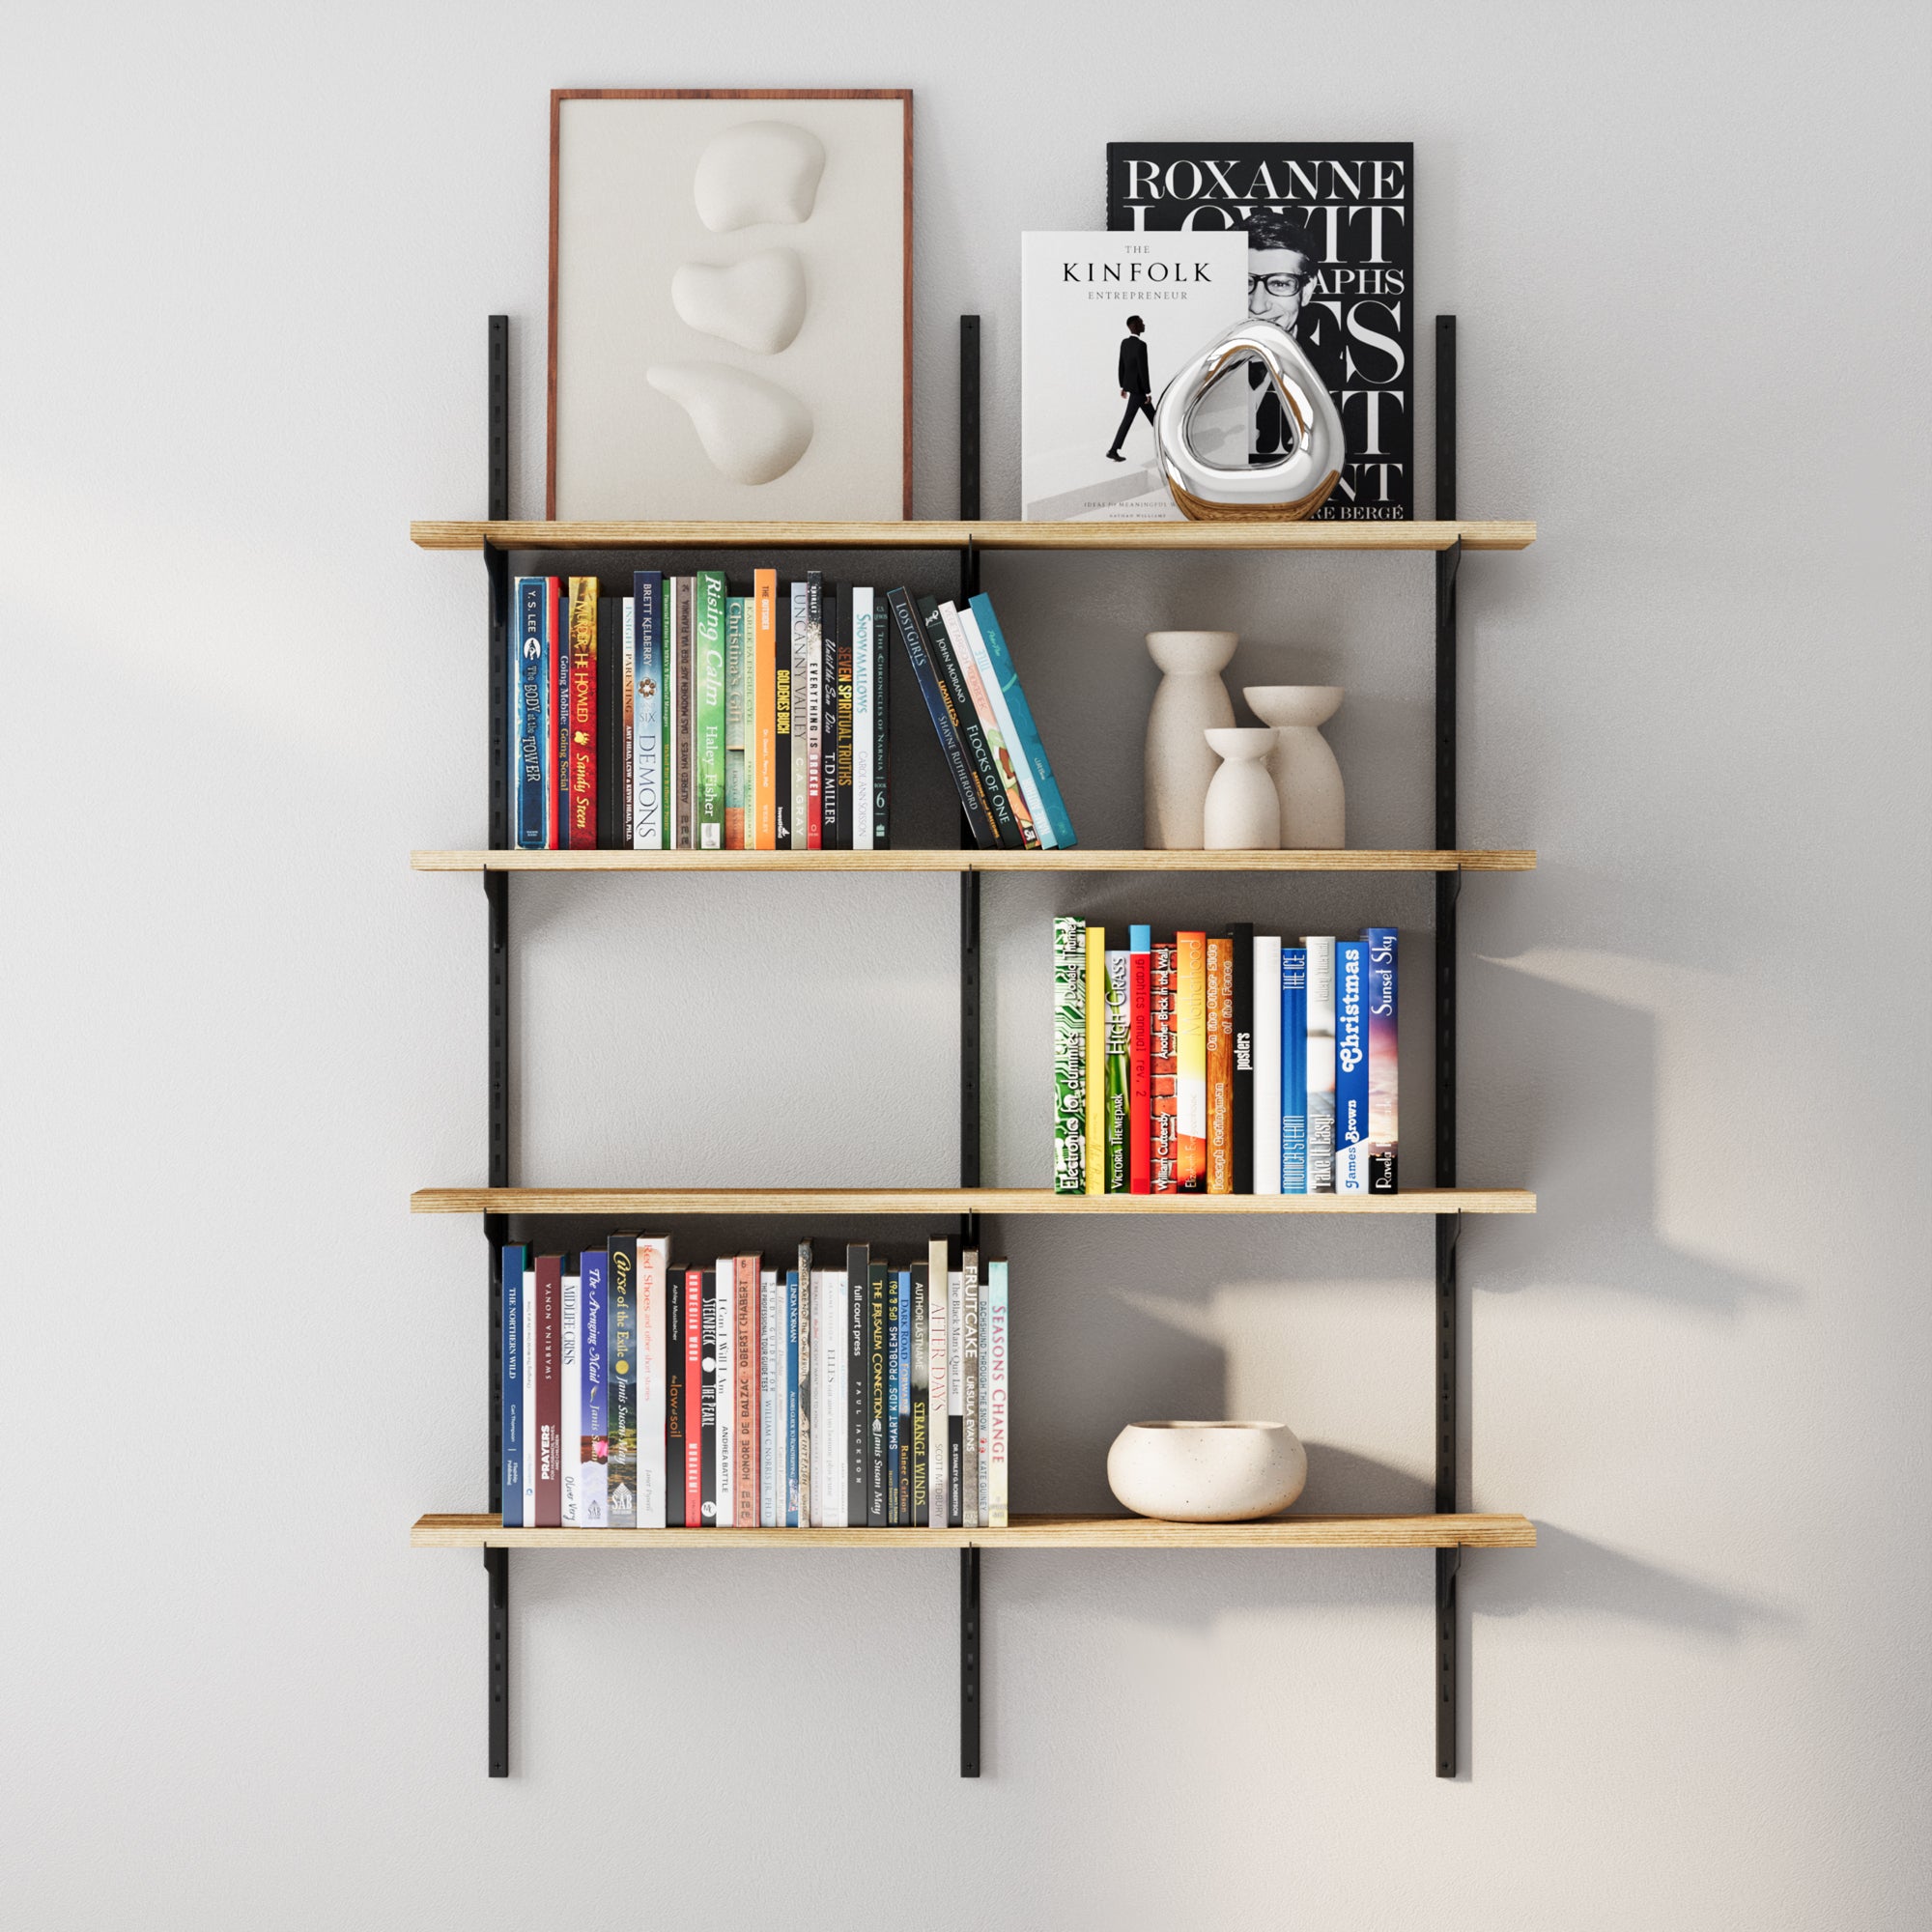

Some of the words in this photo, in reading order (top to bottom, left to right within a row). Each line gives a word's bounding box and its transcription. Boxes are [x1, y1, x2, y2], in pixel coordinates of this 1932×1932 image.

[1122, 159, 1405, 200] ROXANNE
[1124, 245, 1151, 254] THE
[1064, 262, 1212, 282] KINFOLK
[1088, 291, 1188, 300] ENTREPRENEUR
[1340, 505, 1404, 520] BERGÉ
[527, 591, 537, 600] Y.
[527, 602, 537, 611] S.
[642, 583, 652, 615] BRETT
[698, 575, 723, 640] Rising
[527, 614, 537, 633] LEE
[794, 594, 806, 681] UNCANNY
[642, 617, 652, 667] KELBERRY
[729, 602, 741, 686] Christina's
[559, 655, 569, 686] Going
[838, 647, 852, 682] SEVEN
[856, 614, 871, 714] SNOWMALLOWS
[936, 638, 950, 664] JOHN
[946, 664, 966, 704] MORANO
[974, 649, 992, 672] TITLE
[705, 650, 723, 707] Calm
[777, 669, 790, 710] GOLDENES
[559, 688, 569, 725] Mobile:
[729, 692, 741, 723] Gift
[794, 686, 806, 741] VALLEY
[810, 663, 818, 731] EVERYTHING
[838, 684, 852, 741] SPIRITUAL
[640, 711, 656, 723] SIX
[777, 712, 790, 734] BUCH
[877, 719, 884, 732] OF
[559, 728, 569, 759] Going
[702, 725, 718, 766] Haley
[810, 737, 818, 749] IS
[966, 724, 992, 773] FLOCKS
[559, 761, 569, 791] Social
[574, 753, 589, 793] Sandy
[810, 754, 818, 796] BROKEN
[838, 744, 852, 786] TRUTHS
[938, 716, 955, 751] SHAYNE
[952, 752, 978, 811] RUTHERFORD
[637, 735, 659, 838] DEMONS
[703, 774, 718, 817] Fisher
[876, 791, 885, 809] 6
[984, 774, 999, 794] OF
[577, 796, 589, 829] Steen
[991, 791, 1010, 825] ONE
[1208, 944, 1217, 971] Side
[1282, 954, 1305, 969] ICE
[1371, 936, 1397, 964] Sky
[1105, 957, 1126, 1006] GRASS
[1180, 939, 1203, 1036] Motherhood
[1208, 975, 1217, 1009] Other
[1222, 960, 1233, 996] Fence
[1282, 972, 1305, 990] THE
[1371, 969, 1392, 1016] Sunset
[1208, 1012, 1217, 1031] the
[1222, 999, 1233, 1018] the
[1339, 949, 1363, 1073] Christmas
[1105, 1015, 1126, 1054] HIGH
[1208, 1035, 1217, 1051] On
[1222, 1022, 1233, 1034] of
[1061, 1032, 1079, 1089] dummies
[1234, 1033, 1252, 1070] posters
[1061, 1097, 1079, 1113] for
[1111, 1094, 1124, 1145] THEMEPARK
[1345, 1099, 1359, 1143] Brown
[1157, 1112, 1170, 1155] Cuttersby
[1282, 1115, 1305, 1151] STEAM
[1309, 1114, 1335, 1145] Easy!
[1061, 1118, 1079, 1189] Electronics
[1110, 1149, 1123, 1189] VICTORIA
[1282, 1152, 1305, 1189] MONICA
[1310, 1149, 1333, 1158] It
[1345, 1147, 1359, 1189] James
[1157, 1158, 1169, 1191] William
[1310, 1160, 1333, 1190] Take
[589, 1268, 599, 1289] The
[615, 1251, 631, 1295] Curse
[872, 1280, 883, 1299] THE
[952, 1281, 961, 1297] The
[564, 1284, 575, 1330] MIDLIFE
[618, 1296, 628, 1308] of
[739, 1280, 748, 1326] CHABERT
[853, 1285, 862, 1302] full
[914, 1282, 923, 1321] AUTHOR
[587, 1291, 600, 1345] Avenging
[618, 1311, 629, 1327] the
[702, 1298, 716, 1346] STEINBECK
[853, 1303, 862, 1329] court
[872, 1302, 883, 1350] JERUSALEM
[952, 1299, 961, 1325] Black
[965, 1265, 978, 1358] FRUITCAKE
[564, 1332, 575, 1365] CRISIS
[618, 1331, 629, 1358] Exile
[739, 1332, 748, 1367] OBERST
[852, 1330, 861, 1356] press
[914, 1322, 923, 1370] LASTNAME
[931, 1304, 946, 1363] AFTER
[952, 1326, 961, 1352] Man's
[993, 1305, 1006, 1382] SEASONS
[589, 1347, 599, 1383] Maid
[951, 1355, 961, 1376] Quit
[616, 1376, 628, 1404] Janis
[702, 1384, 716, 1400] THE
[872, 1352, 883, 1420] CONNECTION
[931, 1366, 946, 1411] DAYS
[952, 1378, 961, 1395] List
[966, 1375, 975, 1416] URSULA
[618, 1406, 628, 1436] Susan
[702, 1402, 716, 1427] PEARL
[915, 1402, 925, 1457] STRANGE
[993, 1389, 1006, 1464] CHANGE
[541, 1425, 550, 1480] PRAYERS
[872, 1432, 882, 1456] Janis
[966, 1419, 975, 1452] EVANS
[615, 1441, 628, 1465] May
[935, 1443, 944, 1471] SCOTT
[872, 1459, 882, 1488] Susan
[915, 1463, 925, 1506] WINDS
[612, 1493, 632, 1510] SAB
[871, 1491, 882, 1515] May
[935, 1473, 944, 1518] MEDBURY
